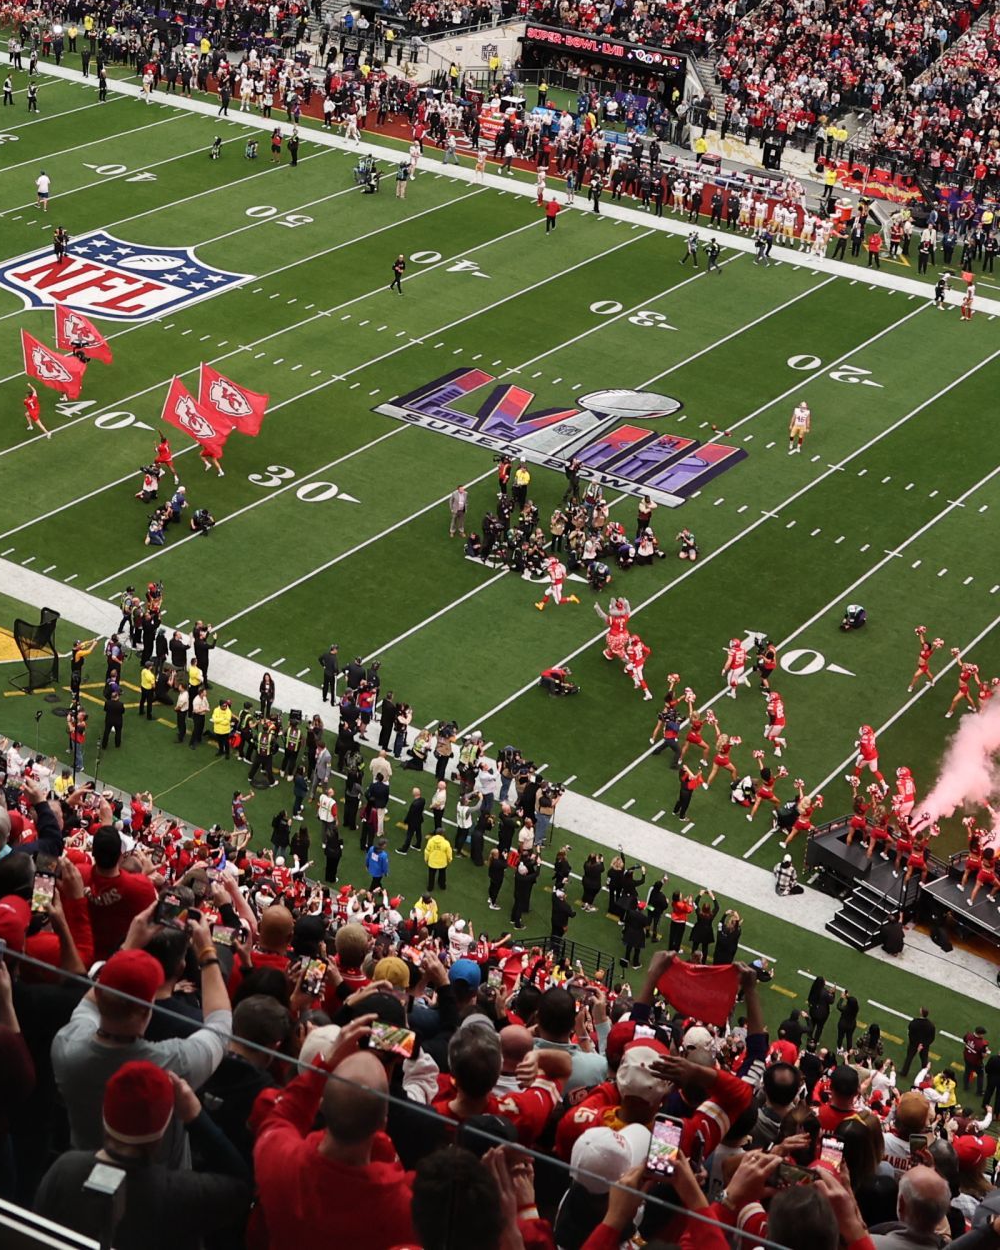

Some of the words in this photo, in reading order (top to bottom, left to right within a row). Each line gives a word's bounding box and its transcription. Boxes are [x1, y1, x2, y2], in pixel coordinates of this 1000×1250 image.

[527, 27, 562, 44] SUPER
[565, 36, 599, 50] BOWL
[602, 43, 624, 57] LVIII
[95, 163, 158, 183] 40
[245, 205, 315, 228] 50
[409, 250, 481, 274] 40
[12, 255, 169, 314] NFL
[589, 300, 668, 328] 30
[787, 354, 873, 385] 20
[56, 400, 138, 431] 40
[401, 412, 524, 456] SUPER
[542, 458, 646, 498] BOWL
[248, 464, 340, 503] 30
